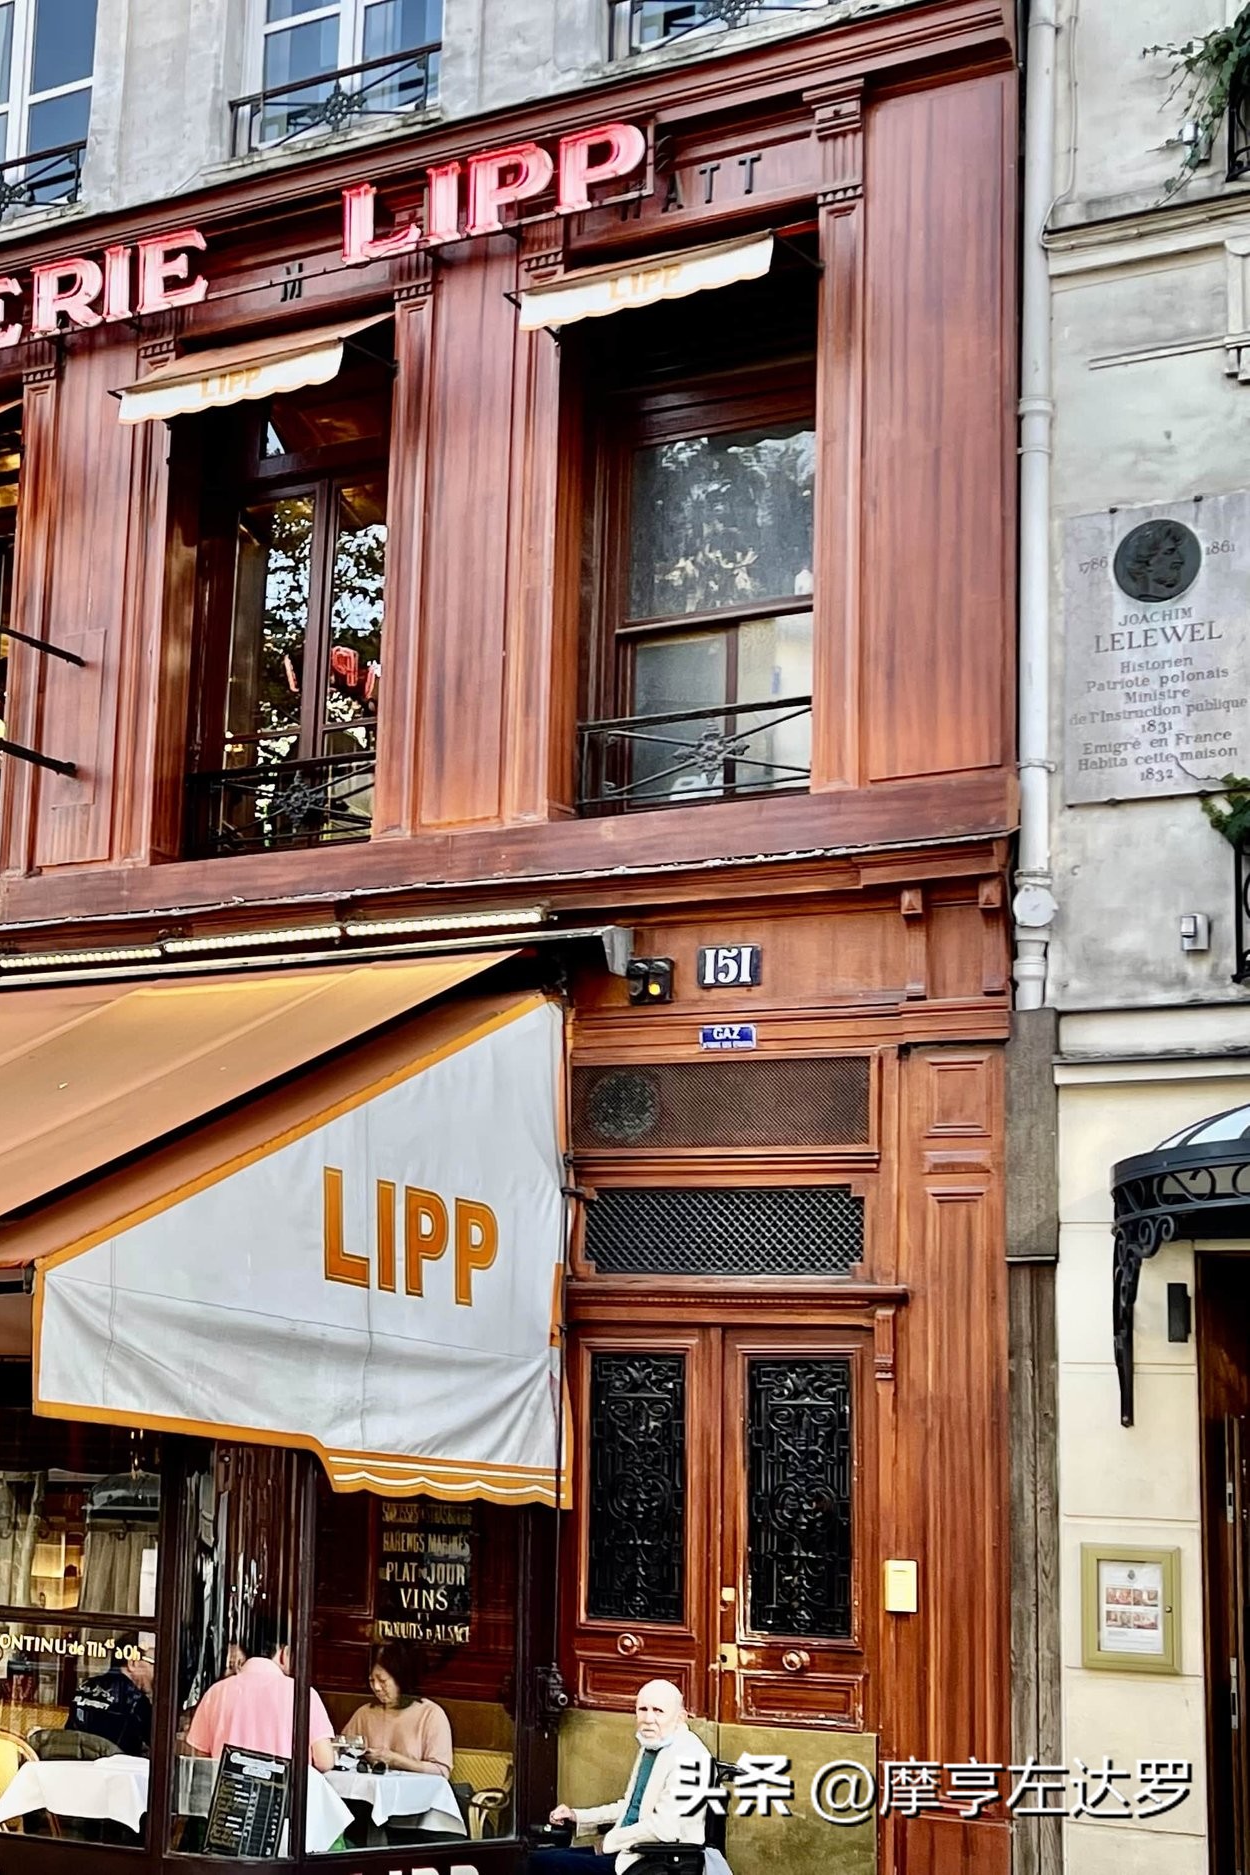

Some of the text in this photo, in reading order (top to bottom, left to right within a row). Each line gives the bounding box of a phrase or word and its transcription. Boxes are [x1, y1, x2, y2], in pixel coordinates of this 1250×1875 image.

[342, 123, 646, 264] LIPP
[609, 263, 682, 299] LIPP
[201, 366, 263, 397] LIPP
[1205, 540, 1236, 556] 1861
[1079, 556, 1109, 575] 1786
[1118, 606, 1193, 627] JOACHIM
[1094, 620, 1223, 654] LELEWEL
[1120, 656, 1194, 674] Historien
[1086, 667, 1230, 693] Patriote polonais
[1124, 688, 1191, 704] Ministre
[1069, 713, 1087, 726] de
[1186, 697, 1248, 717] publique
[1141, 720, 1173, 735] 1831
[1150, 737, 1168, 748] en
[1175, 730, 1232, 746] France
[1078, 754, 1128, 771] Habita
[1180, 746, 1238, 762] maison
[1140, 767, 1174, 782] 1832
[703, 947, 753, 984] 151
[713, 1027, 741, 1040] GAZ
[323, 1165, 499, 1307] LIPP
[385, 1562, 418, 1583] PLAT
[427, 1562, 466, 1586] JOUR
[400, 1588, 449, 1611] VINS
[68, 1640, 85, 1656] de
